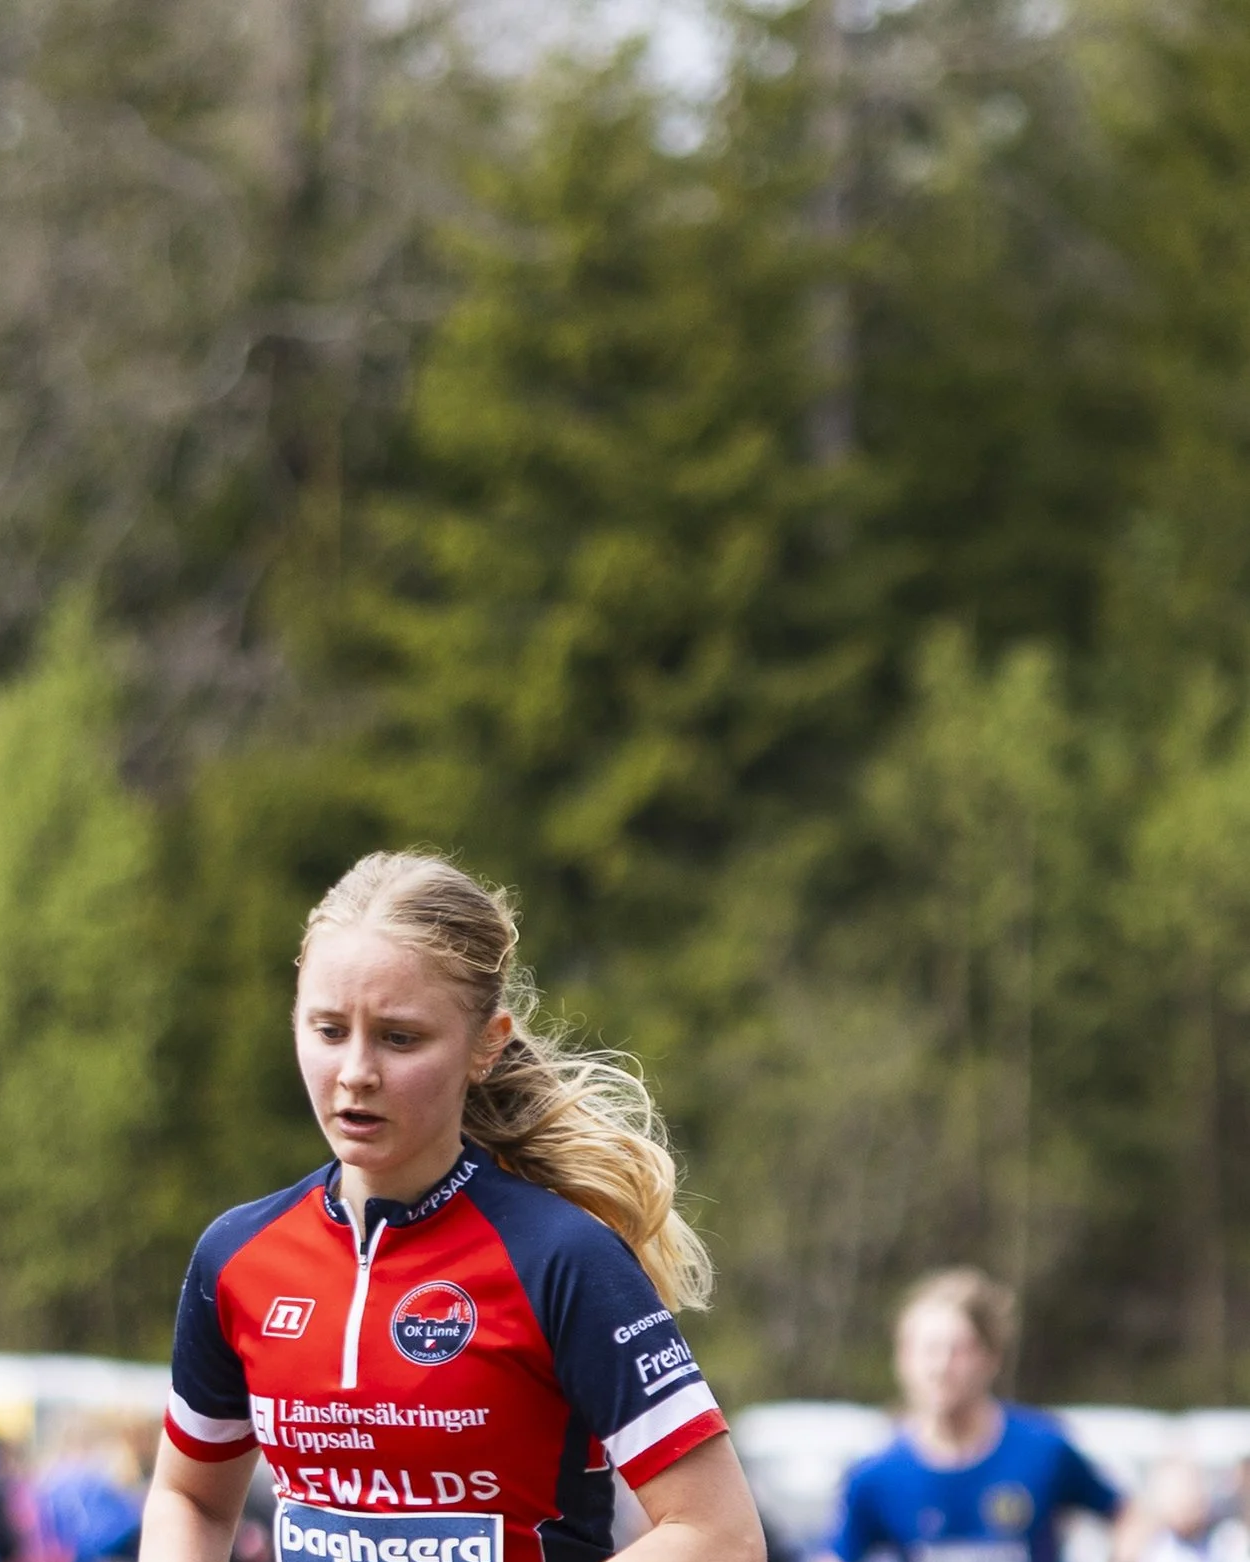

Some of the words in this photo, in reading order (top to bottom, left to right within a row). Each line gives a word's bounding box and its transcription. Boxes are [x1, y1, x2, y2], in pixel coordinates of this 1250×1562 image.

[406, 1160, 479, 1221] UPPSALA
[404, 1325, 424, 1337] OK
[426, 1324, 461, 1337] Linné
[411, 1348, 448, 1360] UPPSALA
[278, 1398, 490, 1433] Länsförsäkringar
[280, 1426, 376, 1454] Uppsala
